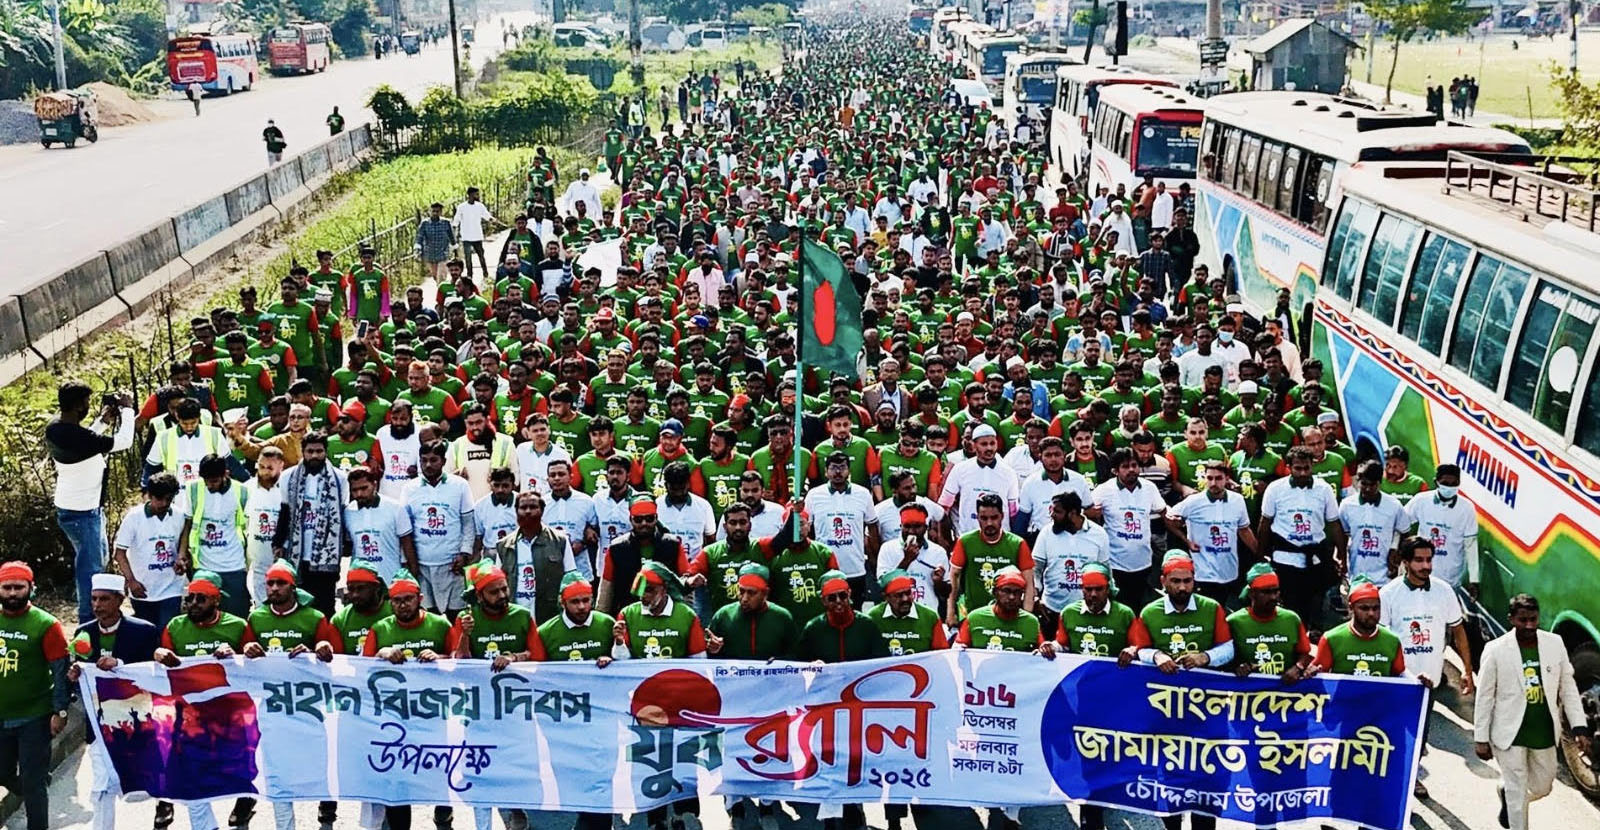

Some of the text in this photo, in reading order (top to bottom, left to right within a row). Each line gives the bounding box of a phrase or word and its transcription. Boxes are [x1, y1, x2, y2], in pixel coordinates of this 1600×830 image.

[1456, 434, 1519, 510] MADINA
[262, 670, 592, 727] মহান বিজয় দিবস
[963, 681, 1018, 710] ১৬
[1146, 681, 1332, 723] বাংলাদেশ
[625, 663, 938, 799] যুব র‍্যালি
[961, 708, 1018, 733] ডিসেম্বর
[368, 721, 497, 792] উপলক্ষে
[952, 755, 1025, 777] সকাল ৯টা
[958, 738, 1019, 759] মঙ্গলবার
[1073, 724, 1396, 778] জামায়াতে ইসলামী
[867, 765, 933, 789] ২০২৫
[1125, 774, 1333, 814] চৌদ্দগ্রাম উপজেলা
